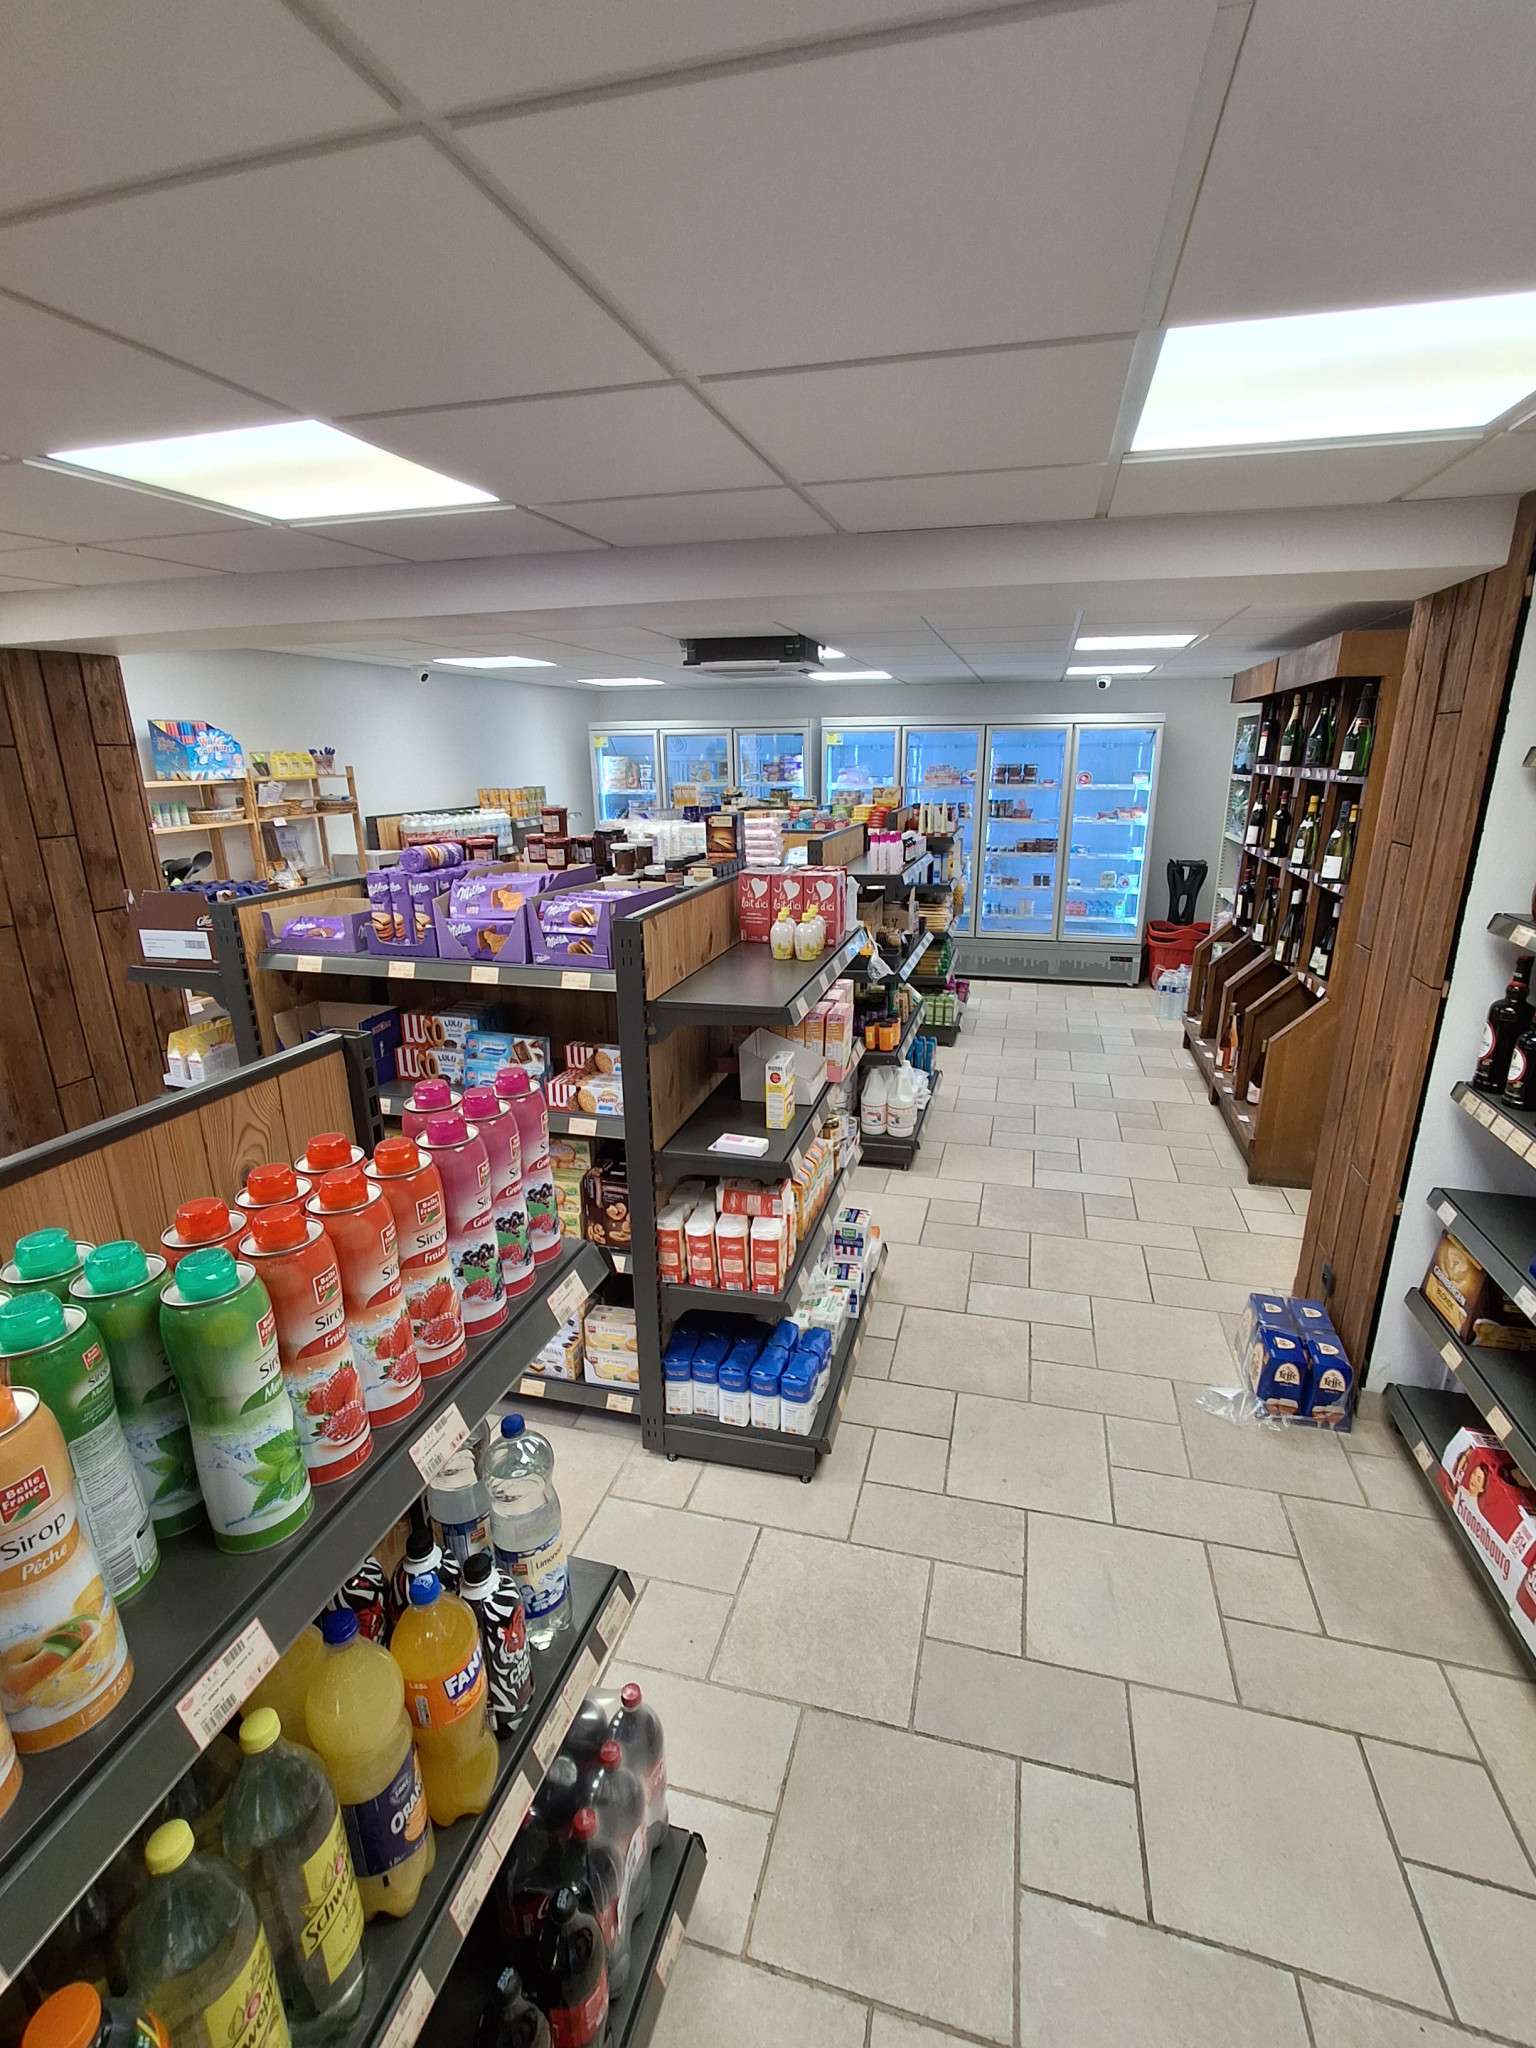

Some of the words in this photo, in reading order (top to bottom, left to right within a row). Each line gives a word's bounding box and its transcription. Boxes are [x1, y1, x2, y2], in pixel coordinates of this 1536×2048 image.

[456, 884, 487, 901] Milka
[741, 897, 754, 908] lait
[446, 922, 473, 937] Milka
[545, 934, 569, 949] Milka
[402, 1014, 427, 1044] LU
[444, 1018, 463, 1029] LULU
[396, 1048, 422, 1078] LU
[437, 1053, 457, 1064] LULU
[566, 1044, 586, 1069] LU
[548, 1082, 568, 1108] LU
[424, 1246, 447, 1264] Frais
[1279, 1368, 1297, 1380] Leffe
[1324, 1376, 1343, 1388] Leffe
[1, 1480, 46, 1511] France
[5, 1475, 41, 1500] Belle
[0, 1512, 66, 1561] Sirop
[1456, 1492, 1511, 1581] Kronenbourg
[444, 1650, 481, 1699] FAN
